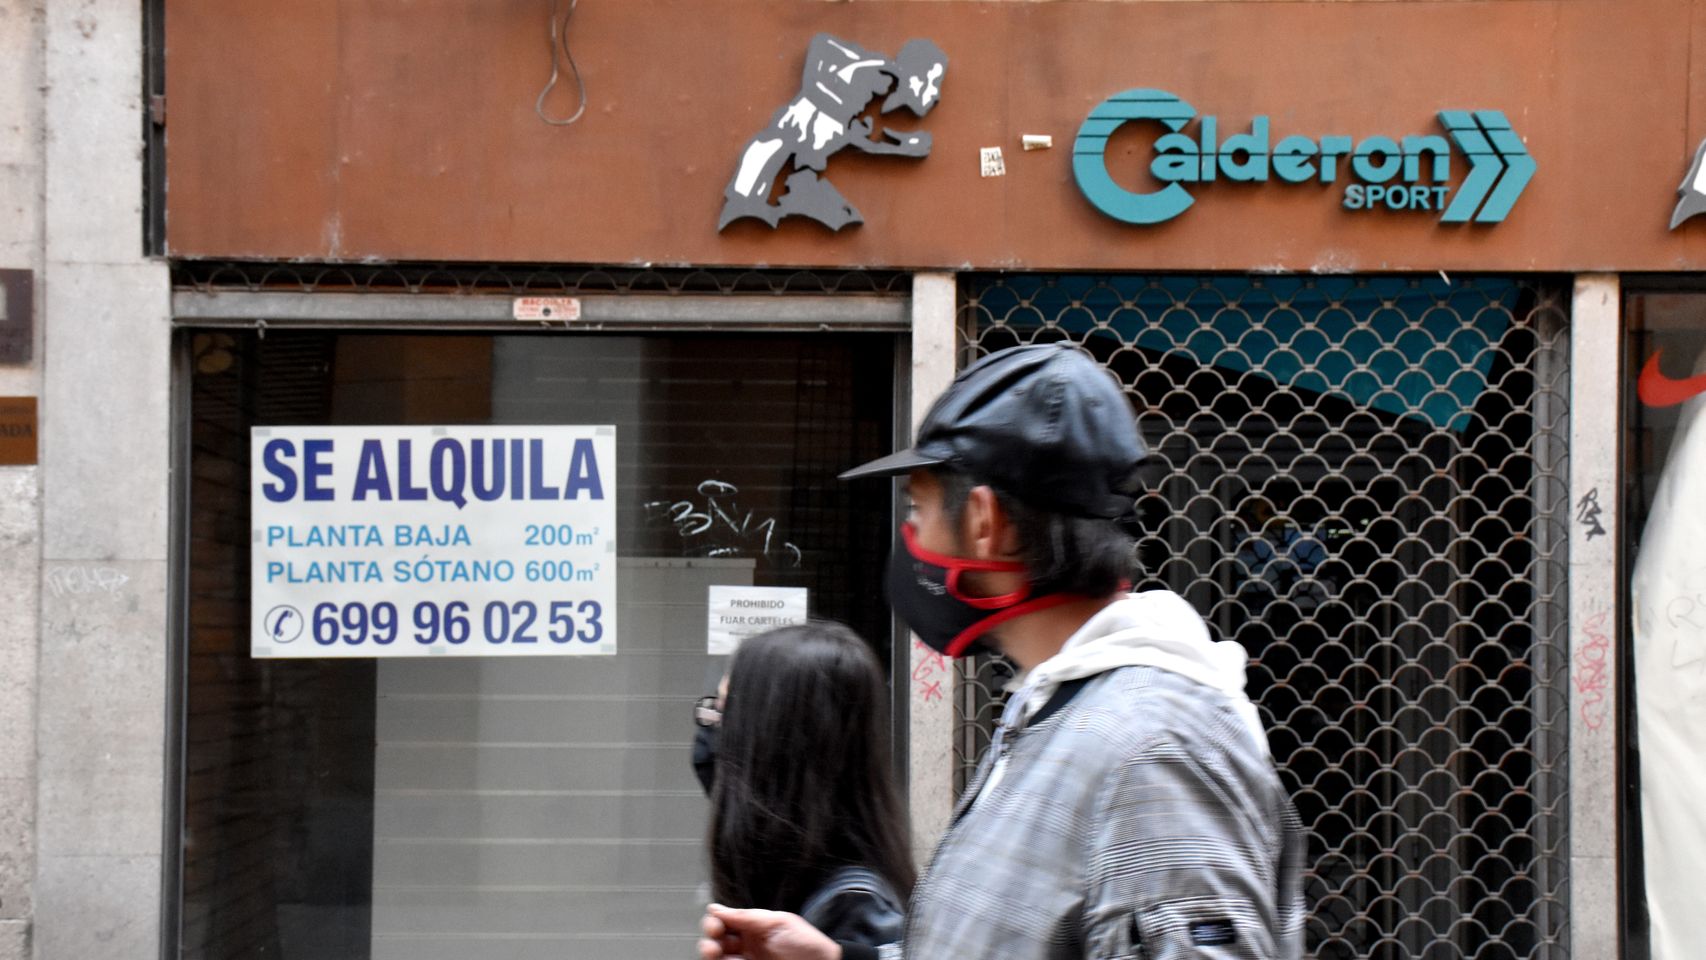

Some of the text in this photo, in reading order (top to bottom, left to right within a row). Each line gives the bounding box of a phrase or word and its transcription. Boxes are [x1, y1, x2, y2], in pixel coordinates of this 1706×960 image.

[1073, 88, 1451, 224] Calderon
[1343, 184, 1451, 210] SPORT
[262, 437, 604, 510] SE ALQUILA
[267, 525, 384, 547] PLANTA
[394, 524, 472, 547] BAJA
[267, 561, 384, 583] PLANTA
[393, 555, 515, 583] SÓTANO
[730, 599, 785, 610] PROHIBIDO
[312, 600, 603, 646] 699 96 02 53
[747, 616, 795, 626] CARTELES
